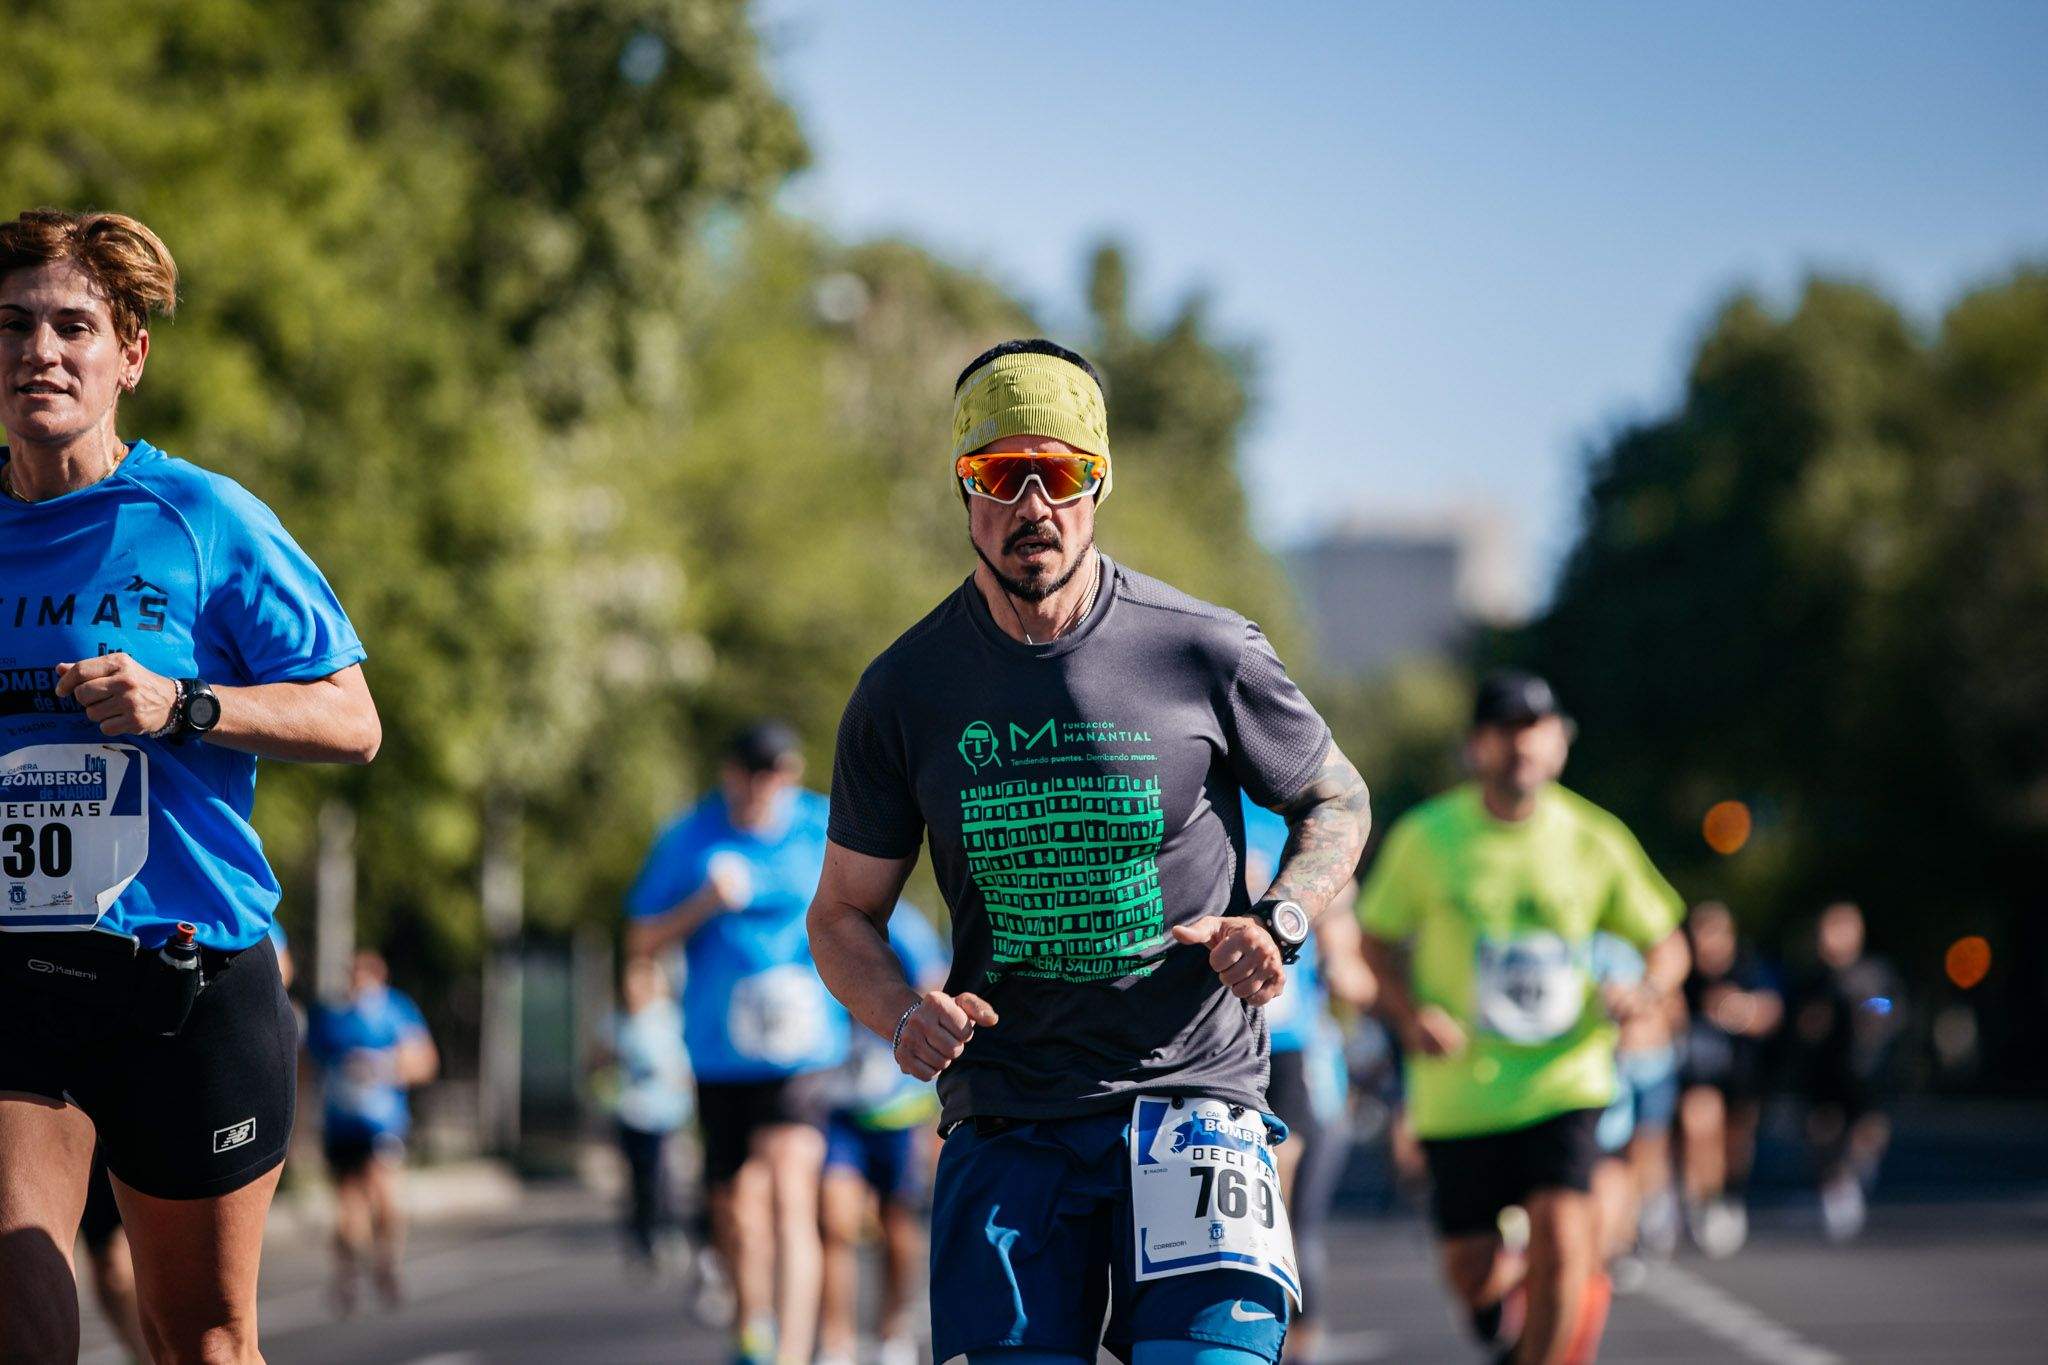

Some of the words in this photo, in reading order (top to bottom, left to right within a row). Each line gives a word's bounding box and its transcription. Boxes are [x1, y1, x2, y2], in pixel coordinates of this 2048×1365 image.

[0, 592, 169, 632] IMAS
[1064, 731, 1152, 743] MANANTIAL
[1010, 756, 1049, 767] Tendiendo
[1051, 754, 1084, 764] puentes.
[1, 771, 102, 787] BOMBEROS
[40, 786, 54, 800] de
[57, 785, 103, 799] MADRID
[0, 802, 101, 819] ECIMAS
[2, 822, 73, 879] 30
[56, 964, 97, 981] Kalenji
[1066, 958, 1113, 974] SALUD
[1190, 1166, 1275, 1230] 769
